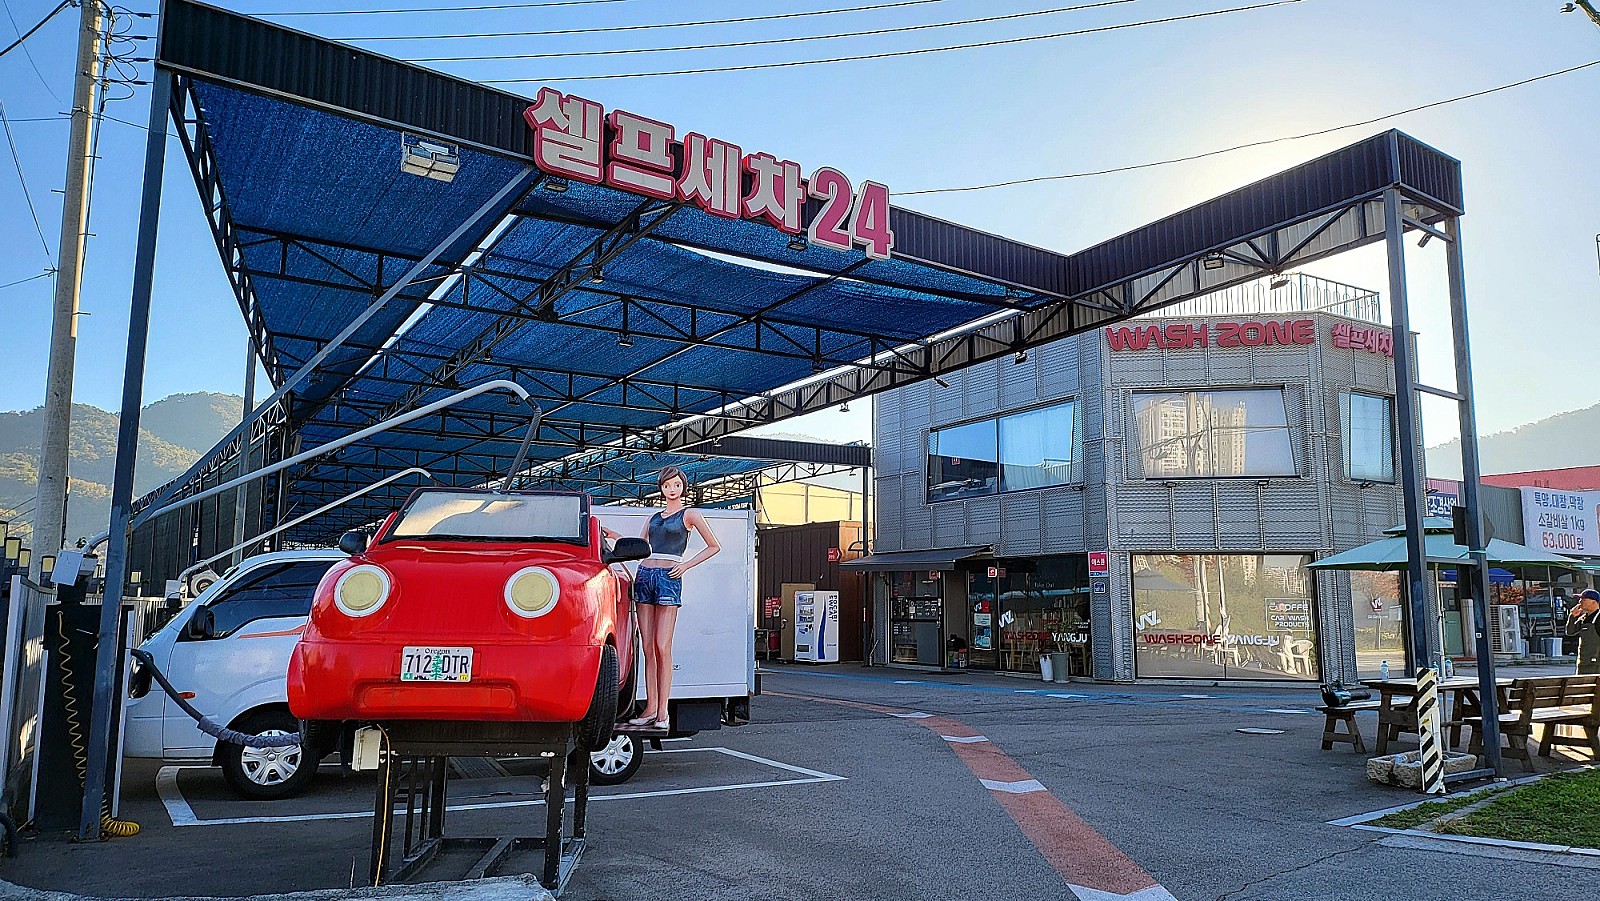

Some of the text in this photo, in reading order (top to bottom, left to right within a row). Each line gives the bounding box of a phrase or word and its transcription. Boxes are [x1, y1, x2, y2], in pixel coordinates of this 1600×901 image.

[1106, 320, 1315, 350] WASH ZONE
[1538, 512, 1585, 531] 소갈비살 1kg
[1052, 632, 1088, 642] YANGJU
[1144, 634, 1221, 644] WASHZONE
[405, 655, 469, 673] 712 DTR
